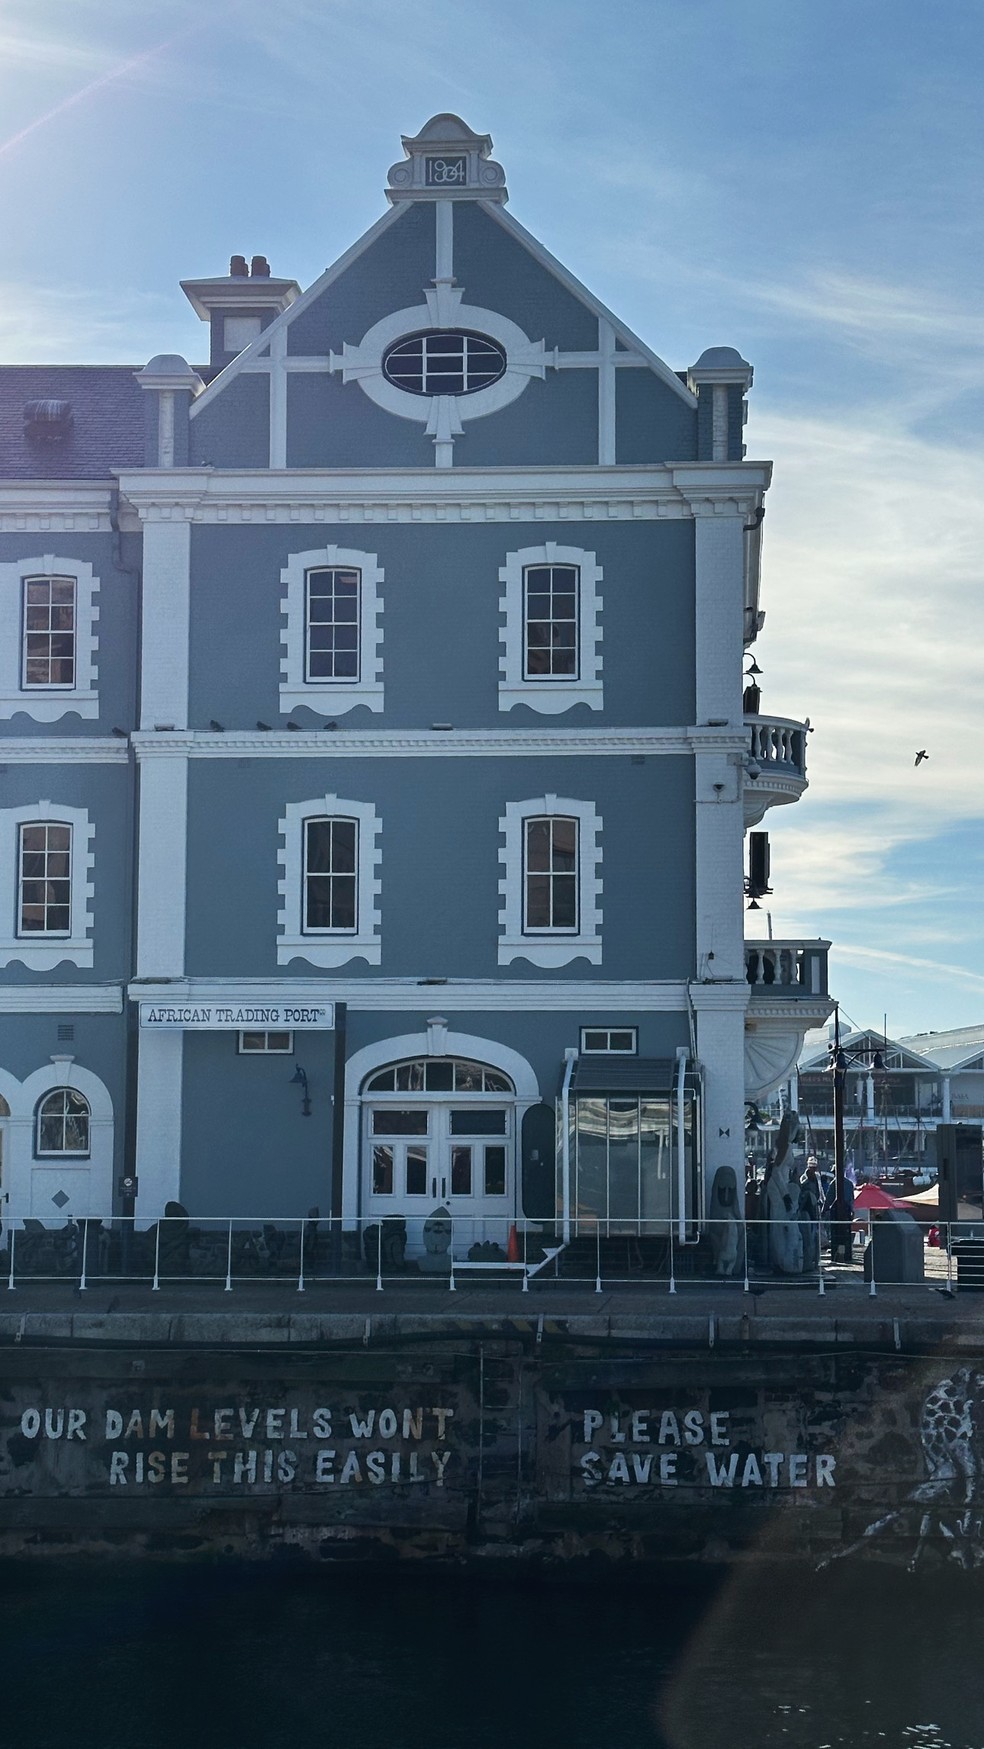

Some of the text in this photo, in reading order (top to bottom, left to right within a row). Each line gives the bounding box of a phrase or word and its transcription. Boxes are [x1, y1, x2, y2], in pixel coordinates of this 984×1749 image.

[148, 1009, 212, 1023] AFRICAN
[216, 1009, 280, 1023] TRADING
[284, 1009, 320, 1023] PORT
[21, 1408, 87, 1440] OUR
[105, 1408, 175, 1440] DAM
[190, 1408, 333, 1441] LEVELS
[583, 1409, 730, 1447] PLEASE
[109, 1450, 452, 1487] RISE THIS EASILY
[580, 1451, 837, 1488] SAVE WATER
